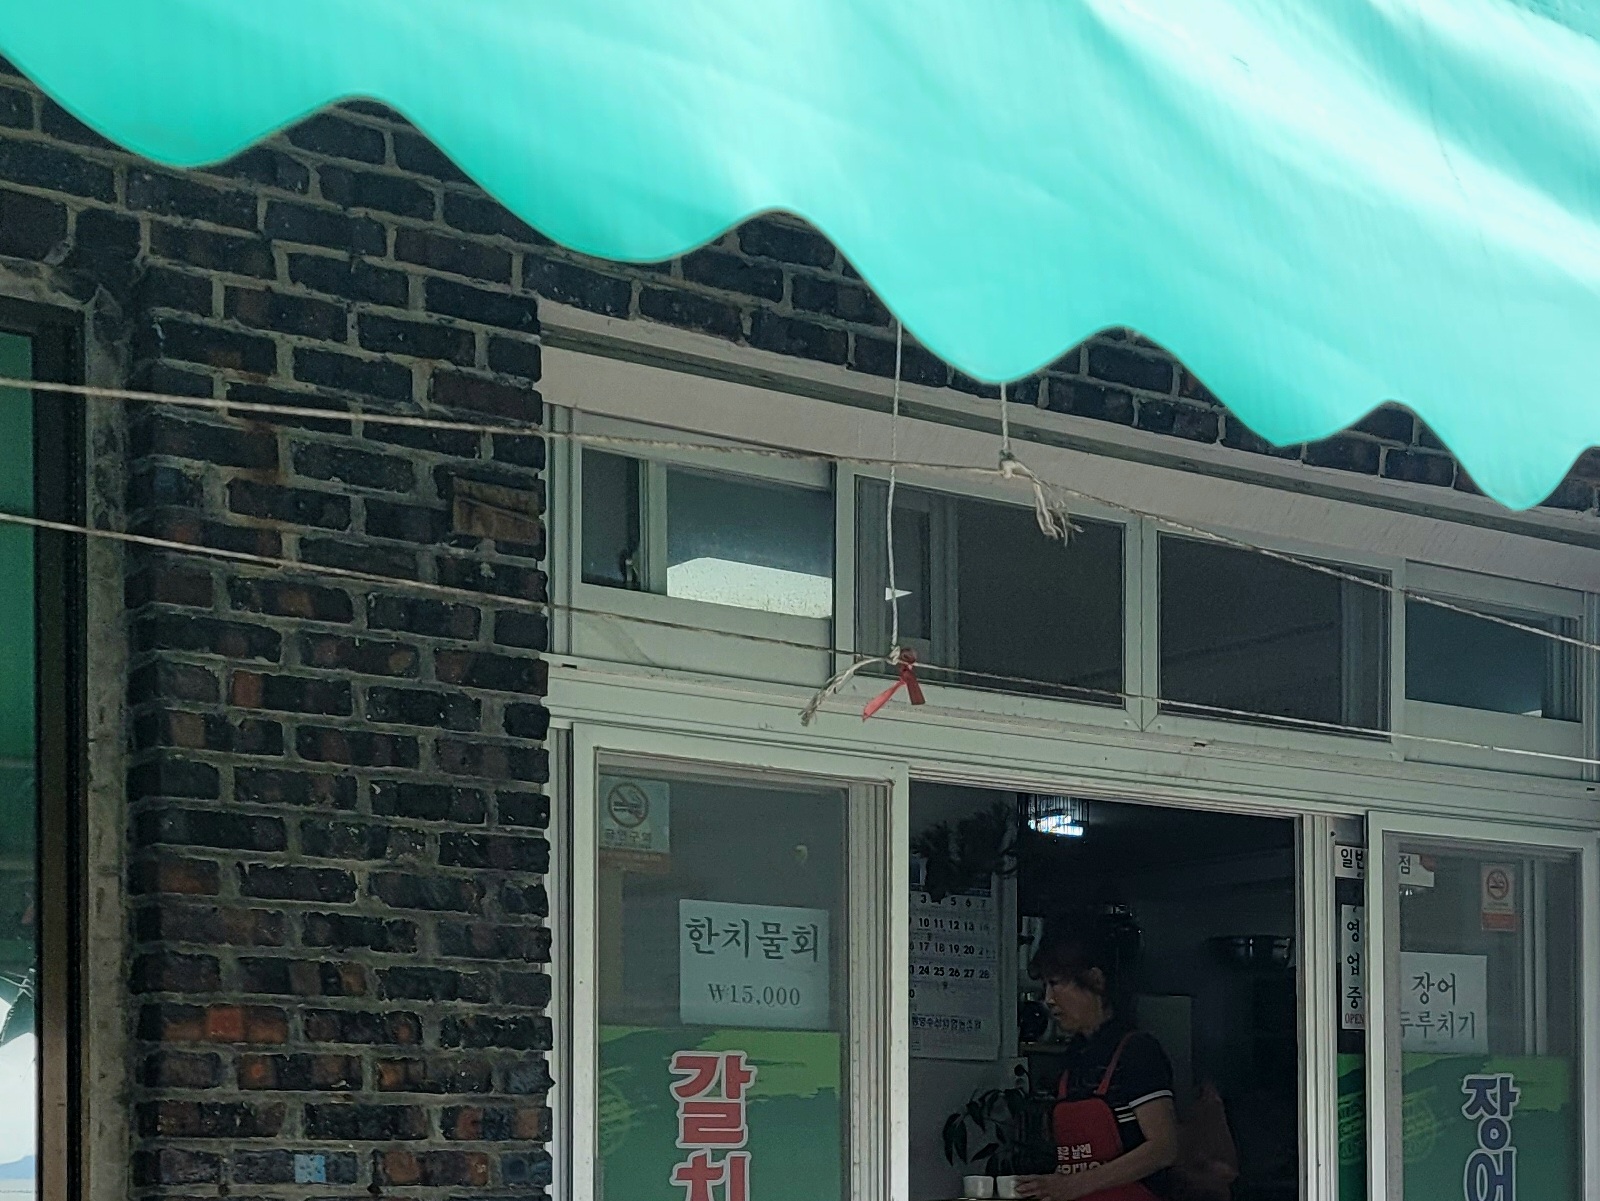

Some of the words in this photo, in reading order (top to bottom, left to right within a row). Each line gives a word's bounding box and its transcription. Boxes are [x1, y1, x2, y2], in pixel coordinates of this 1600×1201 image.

[950, 896, 957, 906] 5
[919, 917, 930, 927] 10
[933, 918, 944, 929] 11
[948, 920, 960, 931] 12
[964, 922, 974, 932] 13
[685, 916, 820, 962] 한치물회
[919, 942, 930, 952] 17
[934, 942, 945, 953] 18
[948, 944, 960, 954] 19
[963, 945, 975, 955] 20
[1346, 918, 1363, 1009] 영업중
[918, 965, 930, 975] 24
[933, 966, 945, 976] 25
[948, 968, 960, 978] 26
[963, 969, 975, 978] 27
[1411, 971, 1457, 1006] 장어
